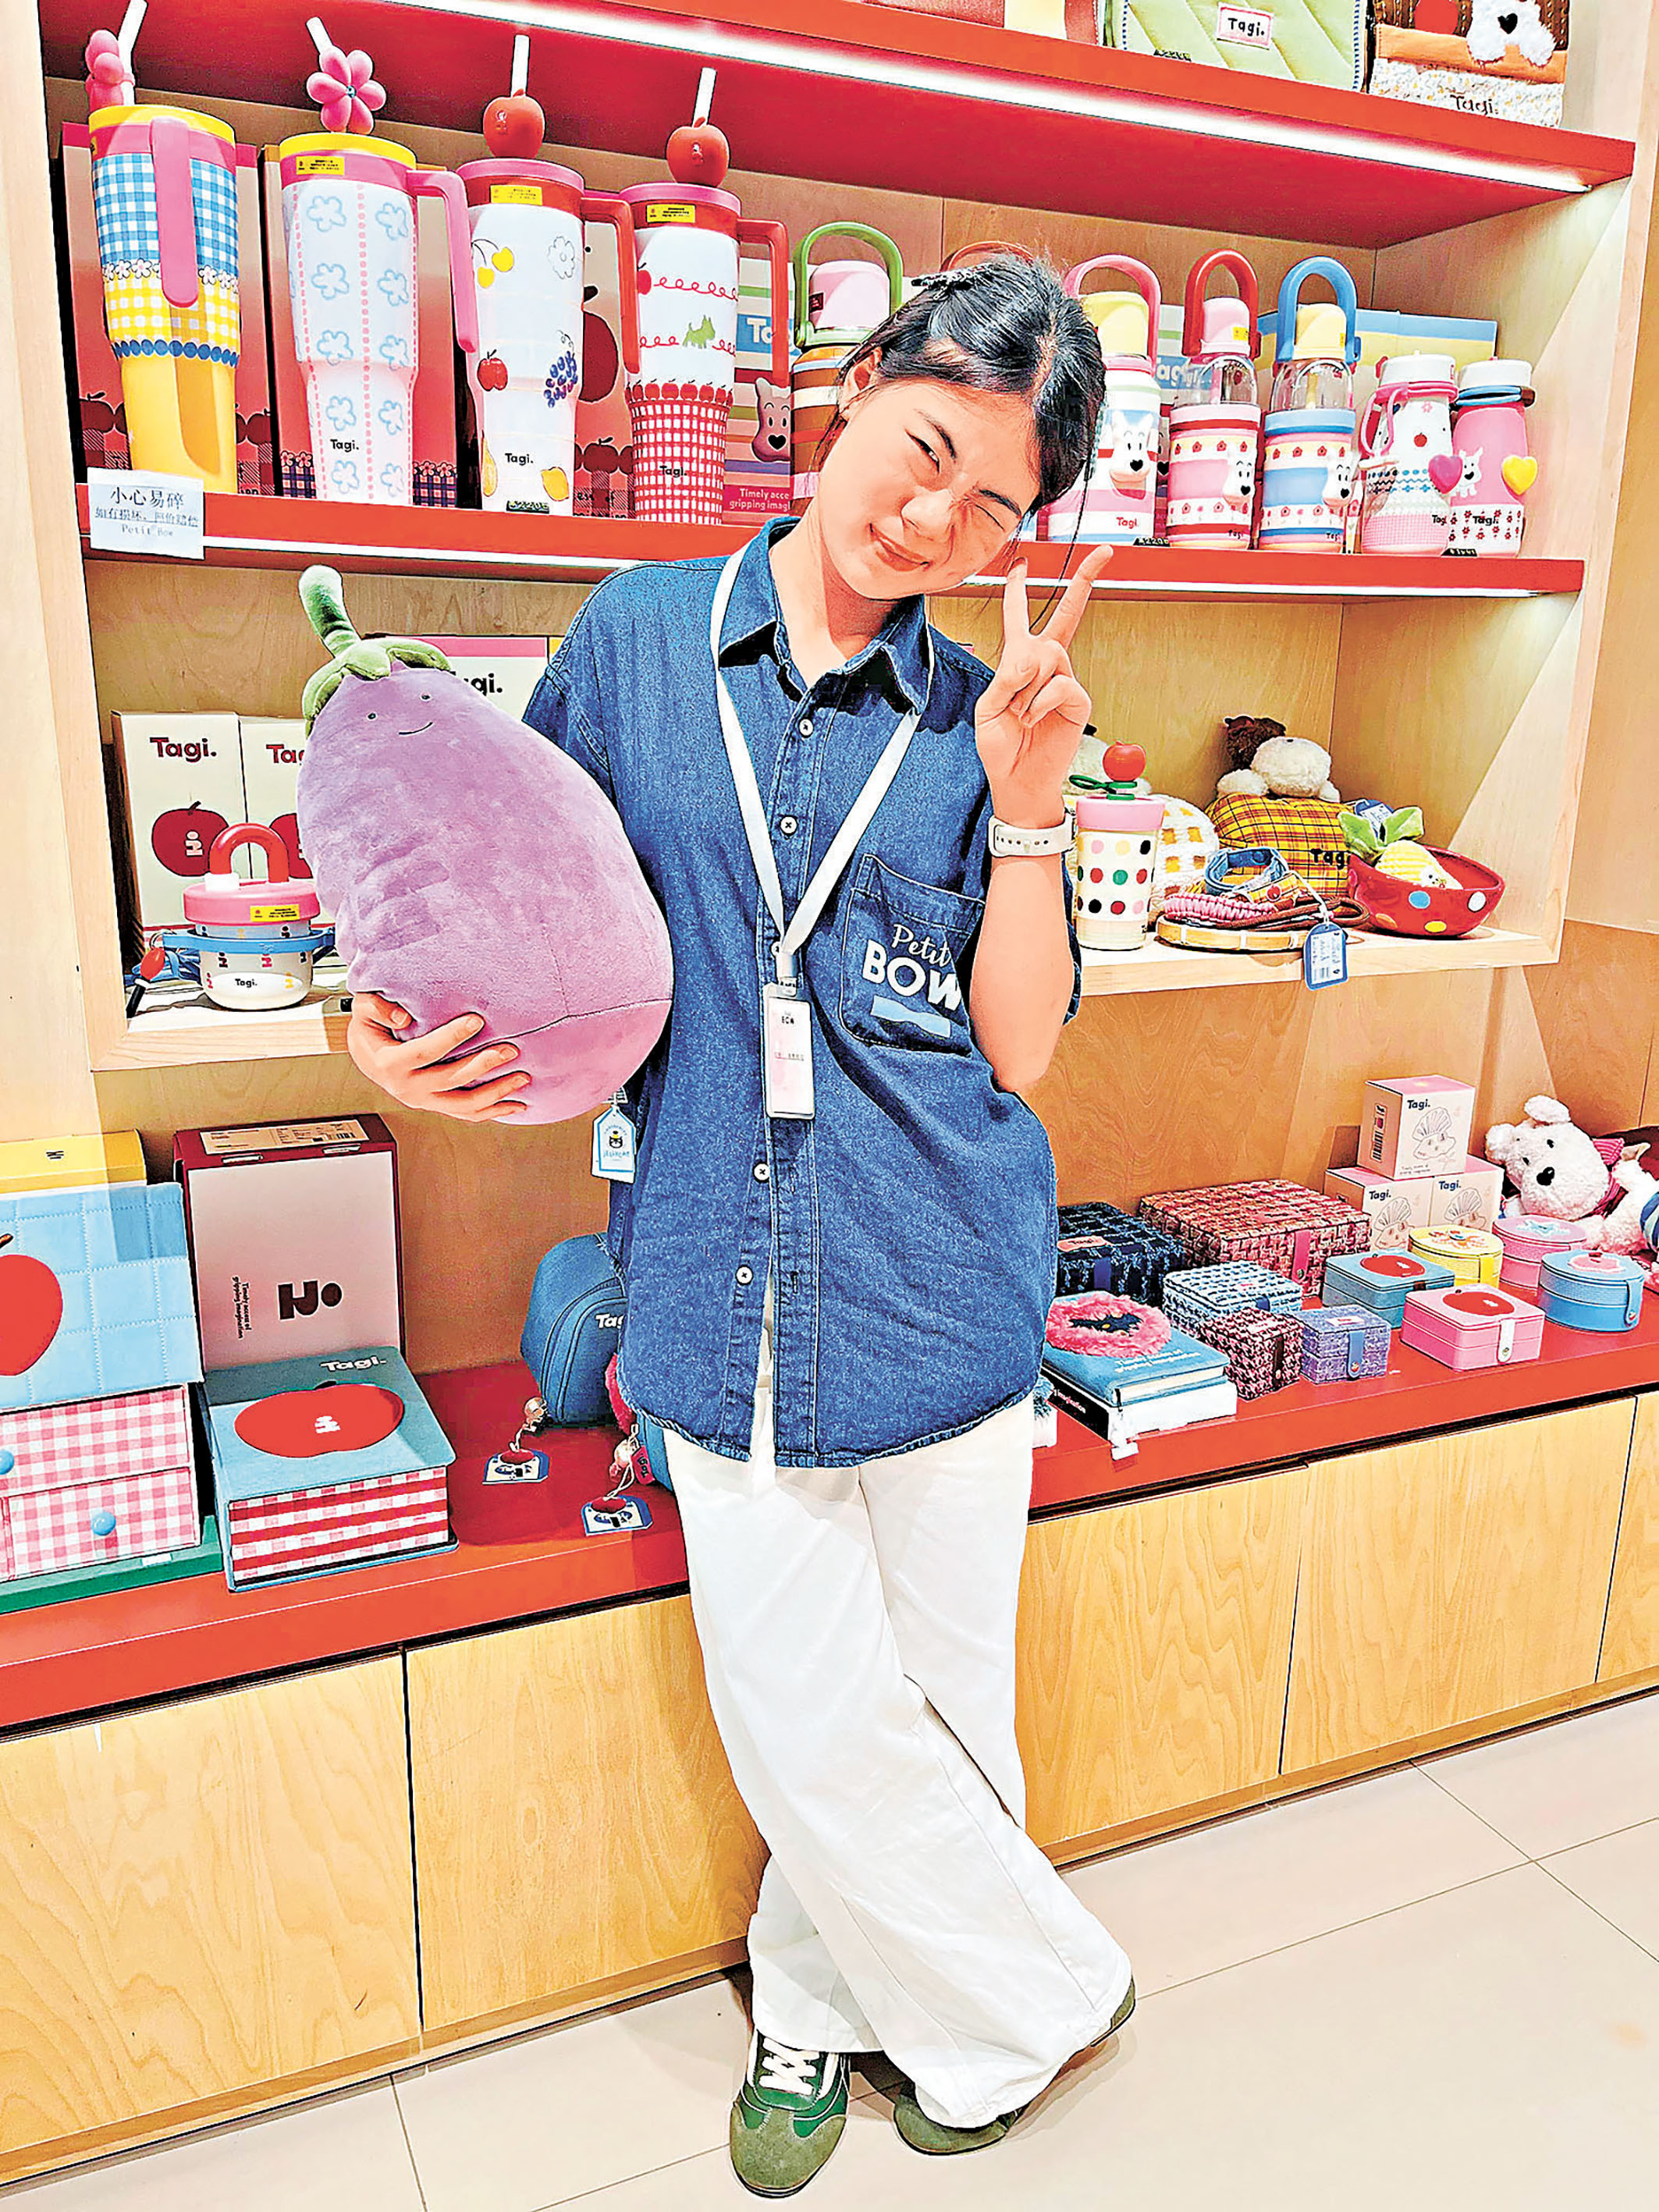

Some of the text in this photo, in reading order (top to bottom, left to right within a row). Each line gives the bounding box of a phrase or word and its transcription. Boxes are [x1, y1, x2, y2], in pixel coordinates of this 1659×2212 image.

[1227, 17, 1265, 37] Tagi.
[329, 438, 359, 453] Tagi.
[505, 453, 534, 466] Tagi.
[659, 465, 687, 478] Tagi.
[110, 486, 184, 510] 小心易碎
[740, 488, 767, 501] Timely
[729, 500, 766, 513] gripping
[150, 737, 217, 762] Tagi.
[891, 924, 951, 968] Petit
[235, 978, 258, 988] Tagi.
[1407, 1099, 1430, 1110] Tagi.
[1438, 1180, 1462, 1191] Tagi.
[1369, 1189, 1391, 1201] Tagi.
[320, 1356, 387, 1372] Tagi.
